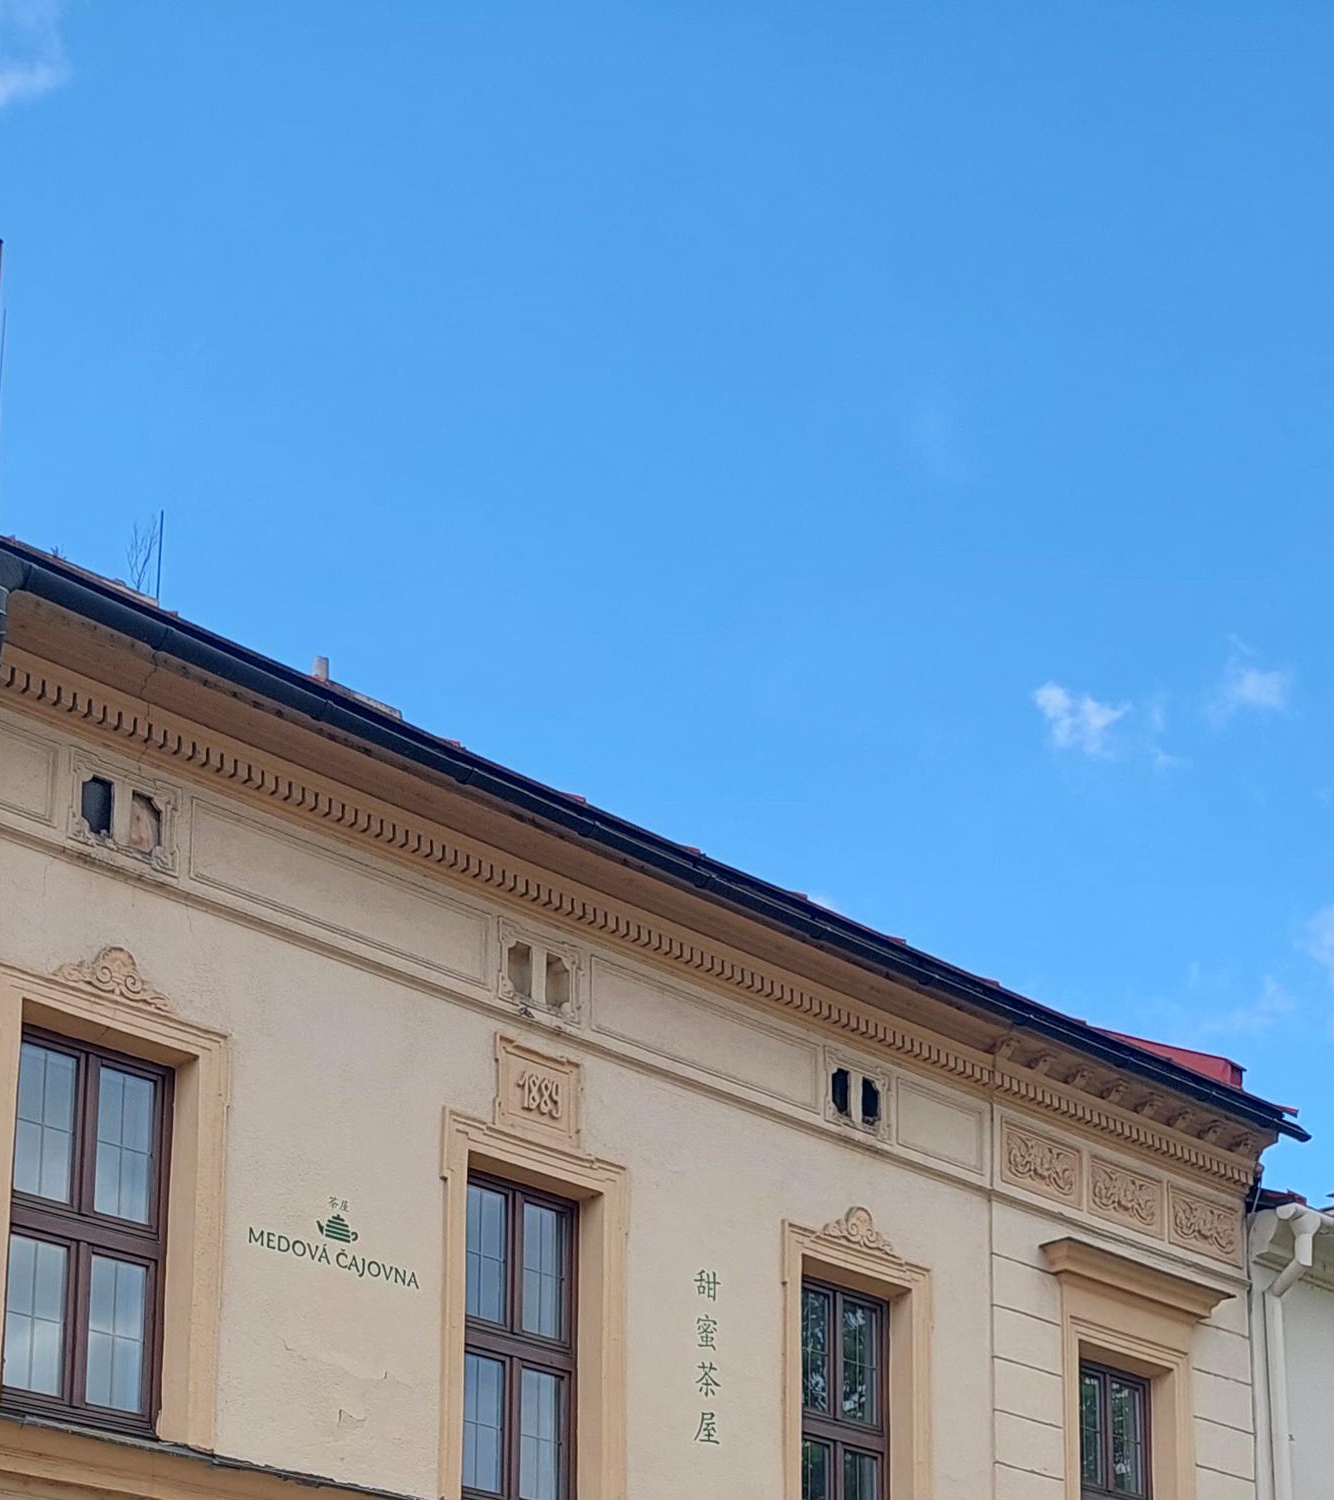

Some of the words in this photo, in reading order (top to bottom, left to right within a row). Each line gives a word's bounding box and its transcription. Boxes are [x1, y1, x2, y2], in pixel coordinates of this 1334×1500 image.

[517, 1072, 561, 1118] 1889
[248, 1226, 331, 1265] MEDOVÁ
[335, 1249, 419, 1289] ČAJOVNA
[693, 1269, 721, 1445] 甜蜜茶屋
